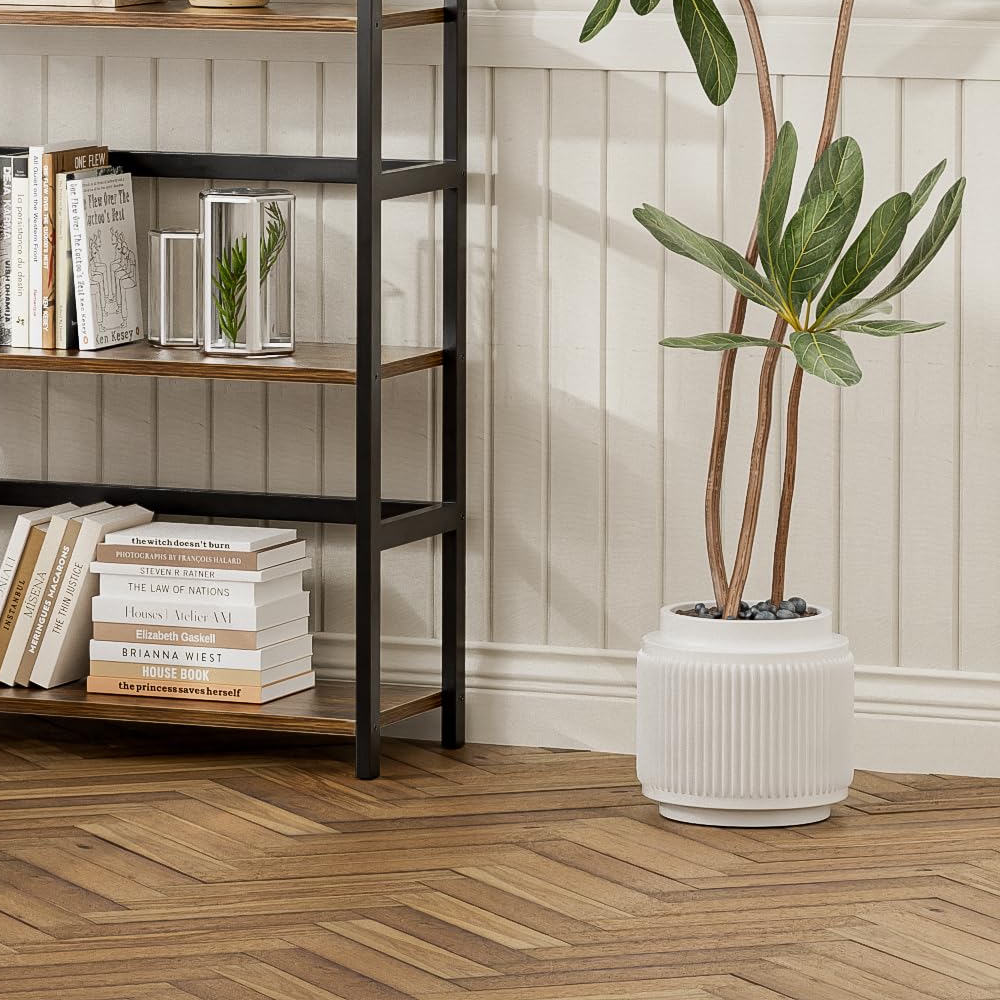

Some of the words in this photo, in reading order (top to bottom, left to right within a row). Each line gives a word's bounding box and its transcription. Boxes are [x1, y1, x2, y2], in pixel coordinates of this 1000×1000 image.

[74, 155, 87, 169] ONE
[88, 152, 106, 167] FLEW
[3, 166, 11, 196] DEJA
[33, 187, 38, 197] on
[88, 194, 103, 208] Flew
[104, 191, 117, 206] Over
[118, 189, 130, 204] The
[74, 234, 82, 247] The
[18, 257, 24, 269] du
[111, 329, 134, 342] Kesey
[131, 537, 147, 545] the
[147, 538, 173, 547] witch
[173, 539, 208, 548] doesn't
[208, 541, 231, 549] burn
[115, 551, 167, 560] PHOTOGRAPHS
[178, 554, 213, 564] FRANÇOIS
[213, 556, 242, 565] HALARD
[66, 562, 84, 596] JUSTICE
[140, 567, 172, 576] STEVEN
[183, 569, 216, 579] RATNER
[128, 582, 147, 592] THE
[150, 584, 170, 593] LAW
[173, 585, 186, 594] OF
[188, 586, 231, 597] NATIONS
[3, 579, 26, 631] INSTANBUL
[28, 600, 52, 654] MERINGUES
[47, 545, 70, 598] MACARONS
[58, 597, 72, 617] THIN
[52, 618, 65, 635] THE
[135, 629, 179, 641] Elizabeth
[180, 632, 216, 644] Gaskell
[122, 647, 179, 660] BRIANNA
[185, 652, 222, 662] WIEST
[142, 665, 178, 679] HOUSE
[180, 668, 210, 681] BOOK
[118, 681, 135, 690] the
[136, 682, 178, 692] princess
[178, 687, 206, 695] saves
[206, 687, 242, 697] herself
